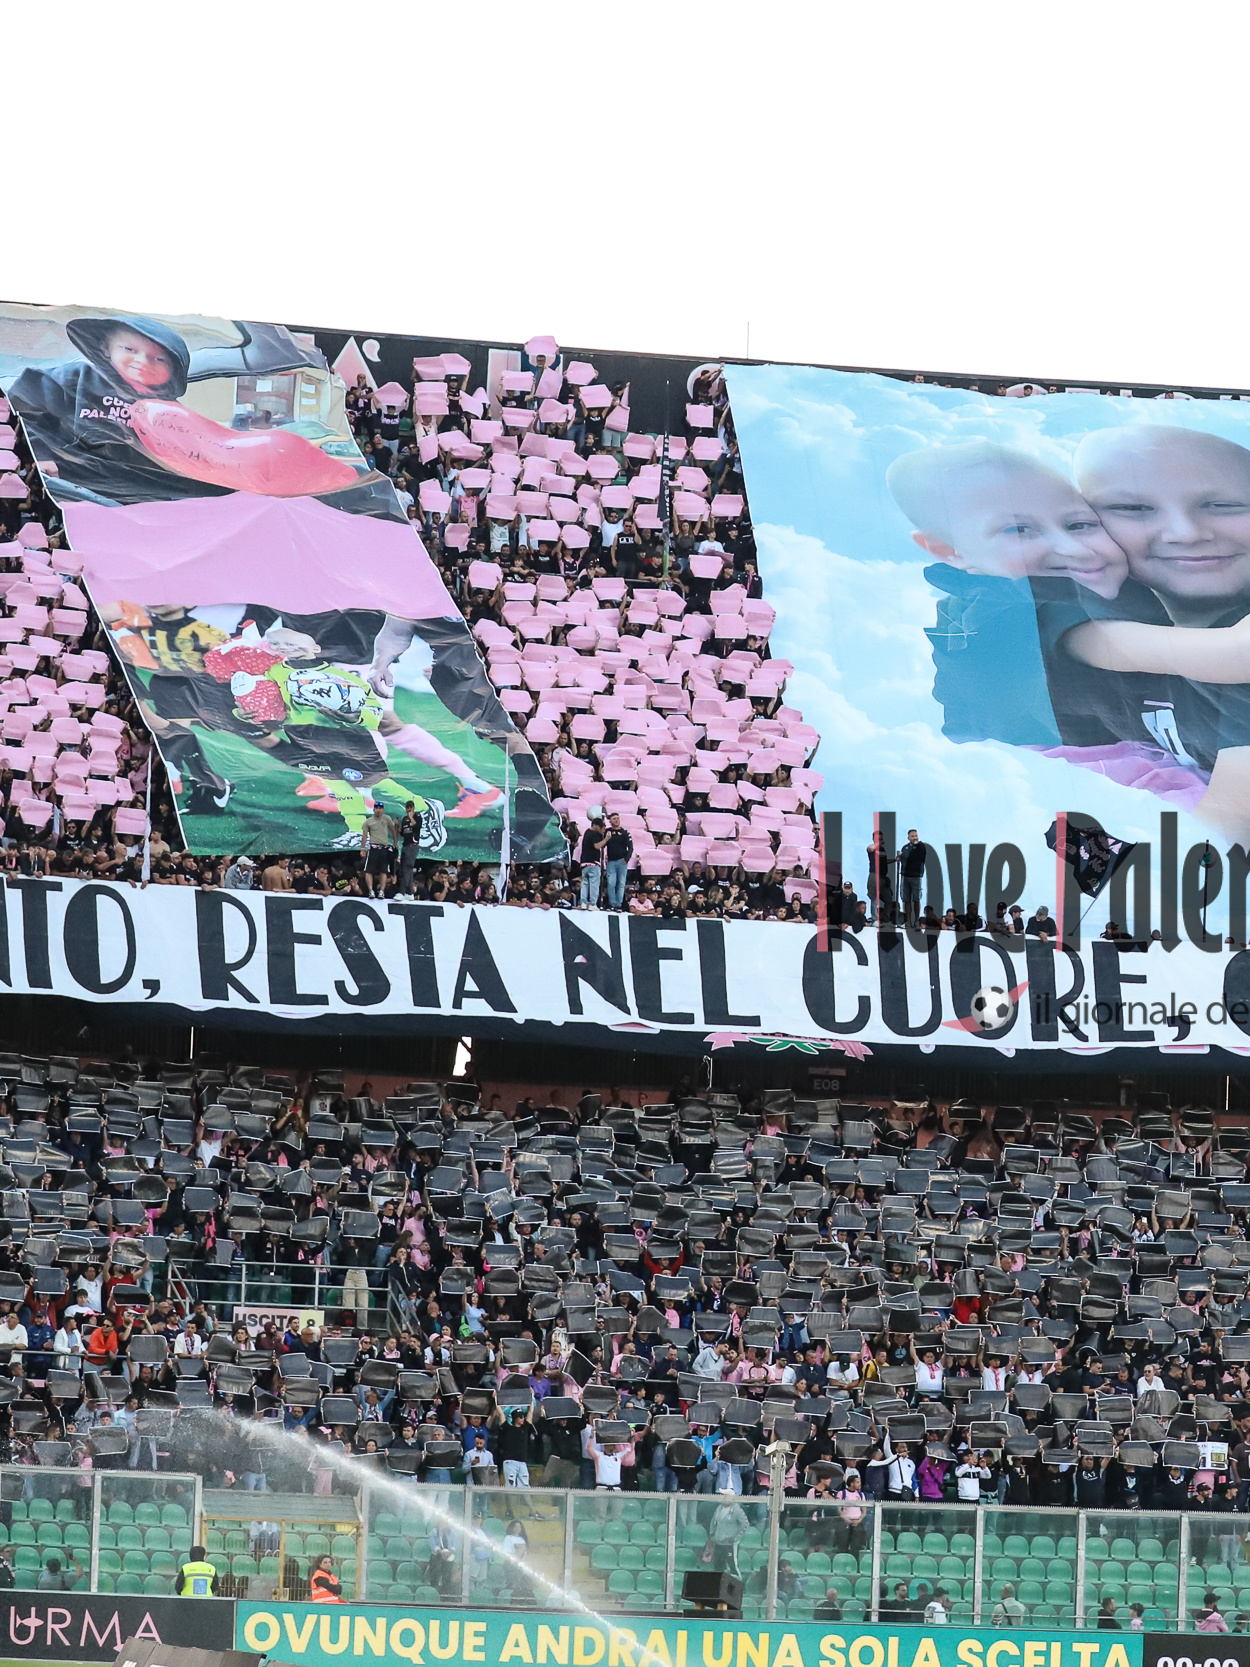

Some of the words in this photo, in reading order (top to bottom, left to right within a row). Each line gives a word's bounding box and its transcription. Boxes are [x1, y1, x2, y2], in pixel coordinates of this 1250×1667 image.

[194, 889, 518, 1014] RESTA
[559, 910, 761, 1027] NEL
[802, 929, 1192, 1042] CUORE,
[235, 1312, 291, 1332] USCIT
[243, 1611, 487, 1665] OVUNQUE
[500, 1625, 688, 1667] ANDRAI
[701, 1630, 804, 1667] UNA
[819, 1633, 943, 1667] SOLA
